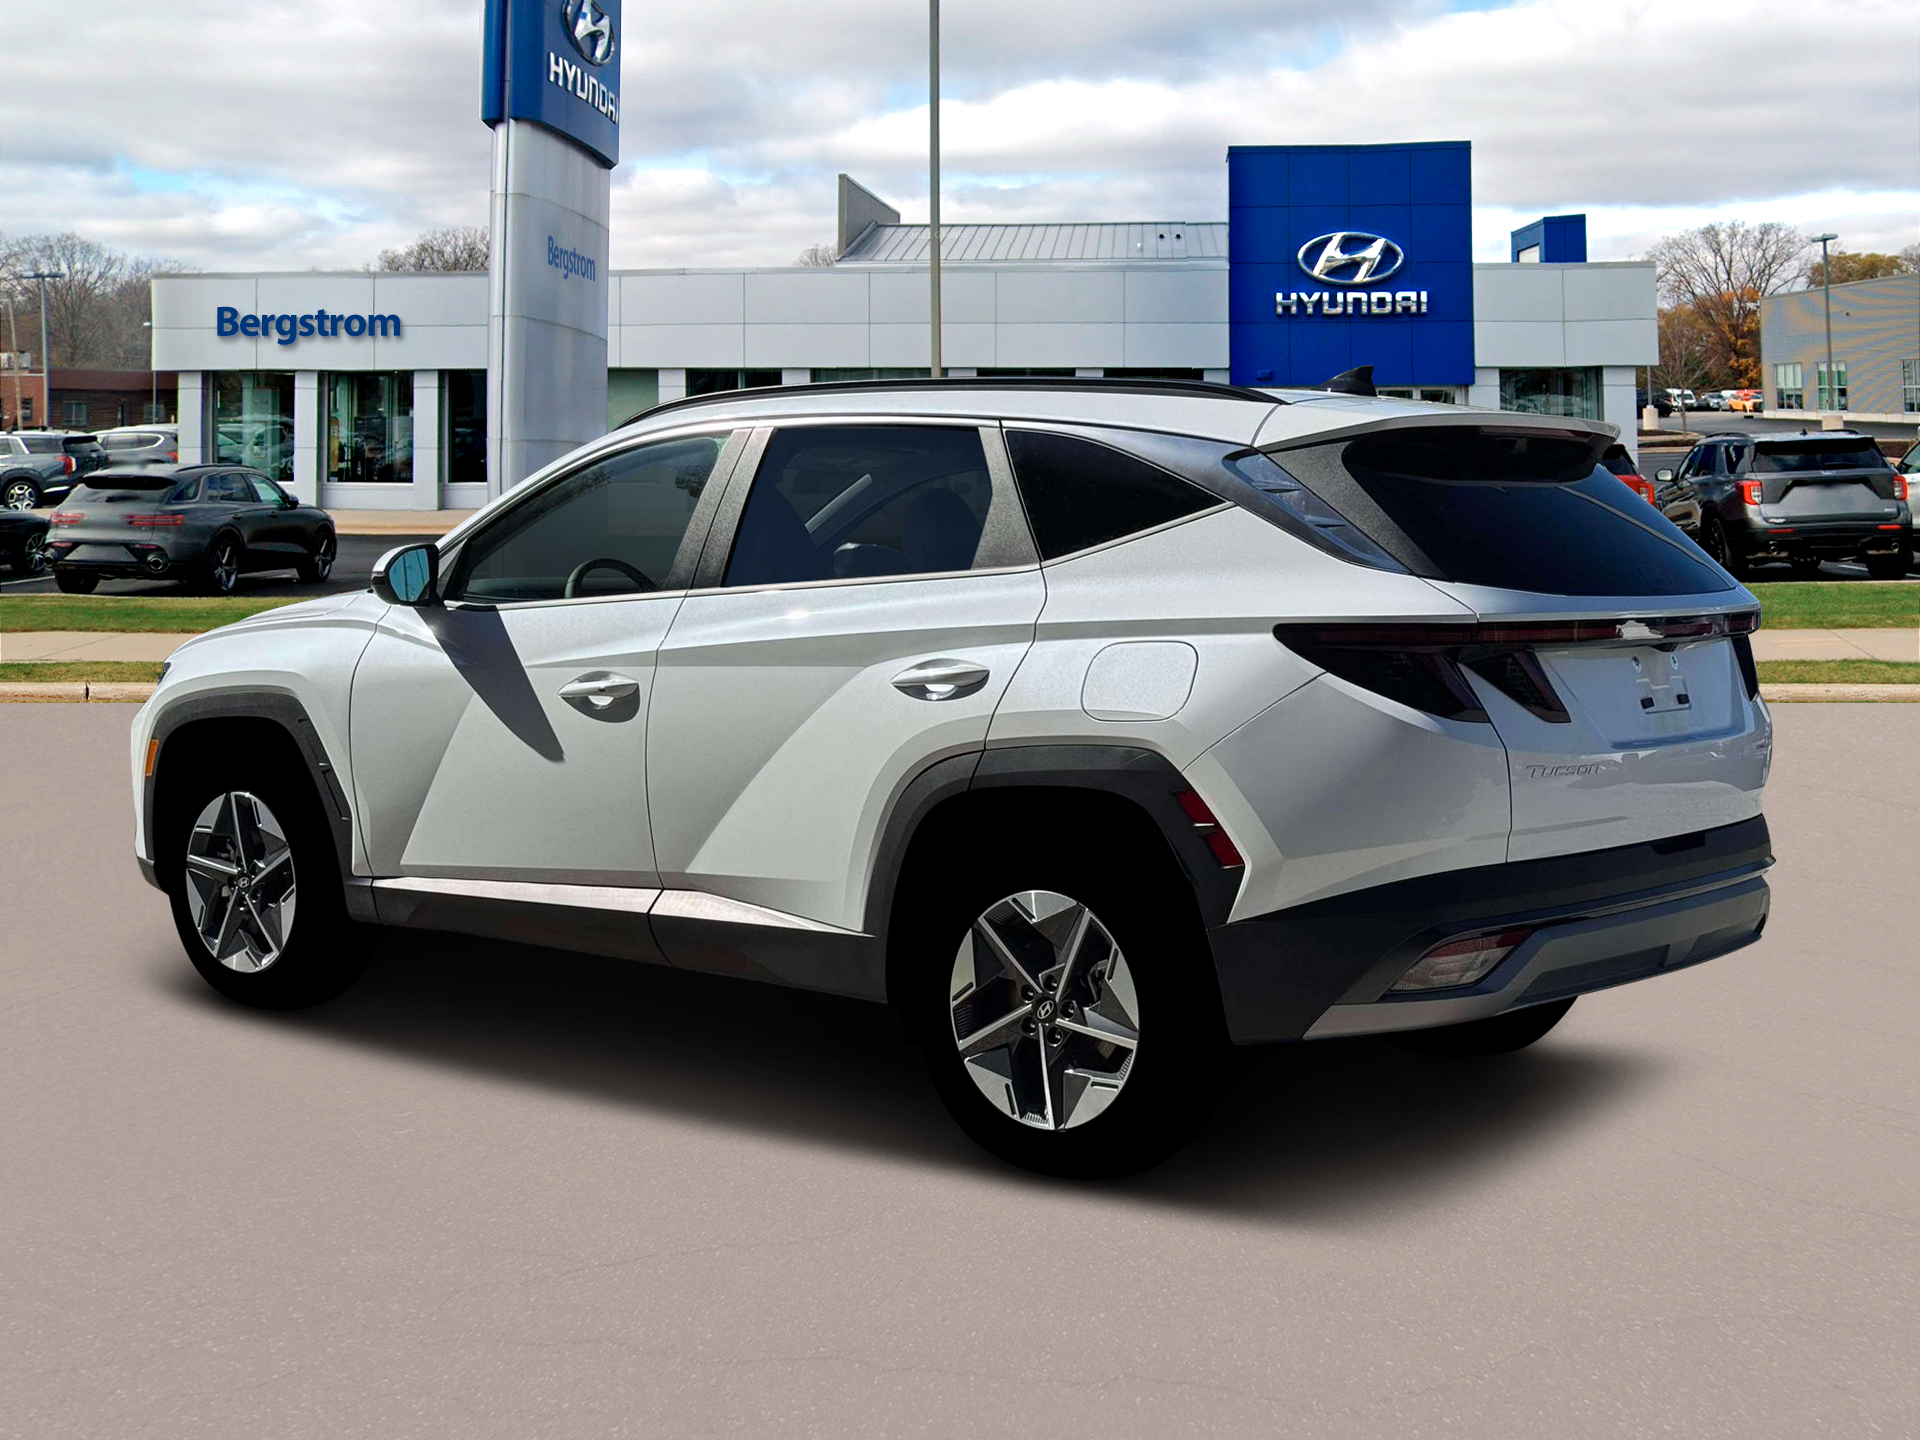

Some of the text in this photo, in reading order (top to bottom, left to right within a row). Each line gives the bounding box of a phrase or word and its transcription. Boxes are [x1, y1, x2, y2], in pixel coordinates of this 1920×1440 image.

[549, 52, 619, 124] HYUNDAI
[548, 235, 595, 282] Bergstrom
[1275, 291, 1428, 315] HYUNDAI
[217, 306, 401, 346] Bergstrom
[1525, 764, 1602, 779] TUCSON
